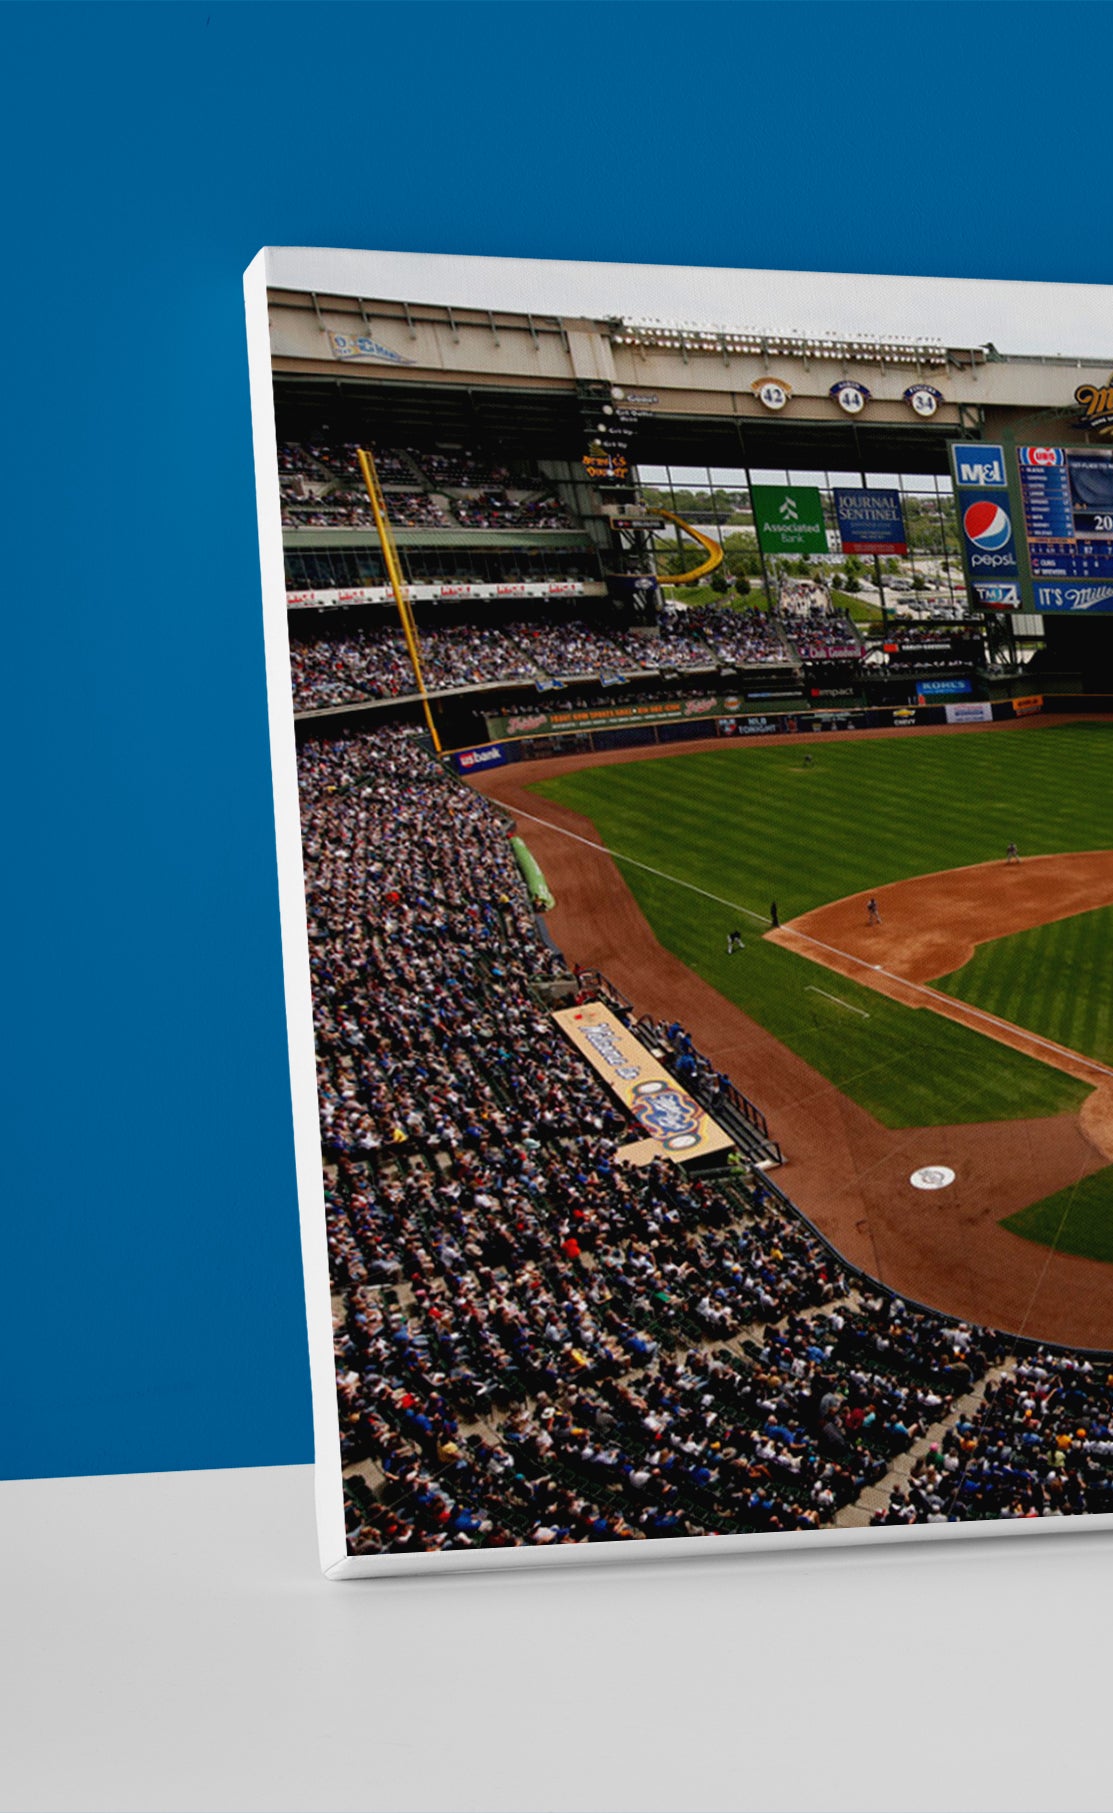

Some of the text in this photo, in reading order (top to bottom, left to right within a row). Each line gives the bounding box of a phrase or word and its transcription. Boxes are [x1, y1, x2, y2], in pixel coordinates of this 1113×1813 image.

[763, 388, 783, 403] 42
[843, 393, 860, 406] 44
[915, 397, 933, 410] 34
[961, 461, 1002, 486] M&I
[838, 496, 897, 509] JOURNAL
[839, 508, 899, 521] SENTINEL
[763, 522, 820, 533] Associated
[1094, 515, 1113, 531] 20
[781, 533, 804, 543] Bank
[971, 553, 1016, 567] pepsi
[1039, 588, 1063, 606] IT'S
[922, 680, 966, 690] KOHL'S
[818, 687, 854, 697] impact
[894, 718, 916, 726] CHEVY
[738, 724, 776, 735] TONIGHT
[577, 1022, 641, 1080] Welcome to
